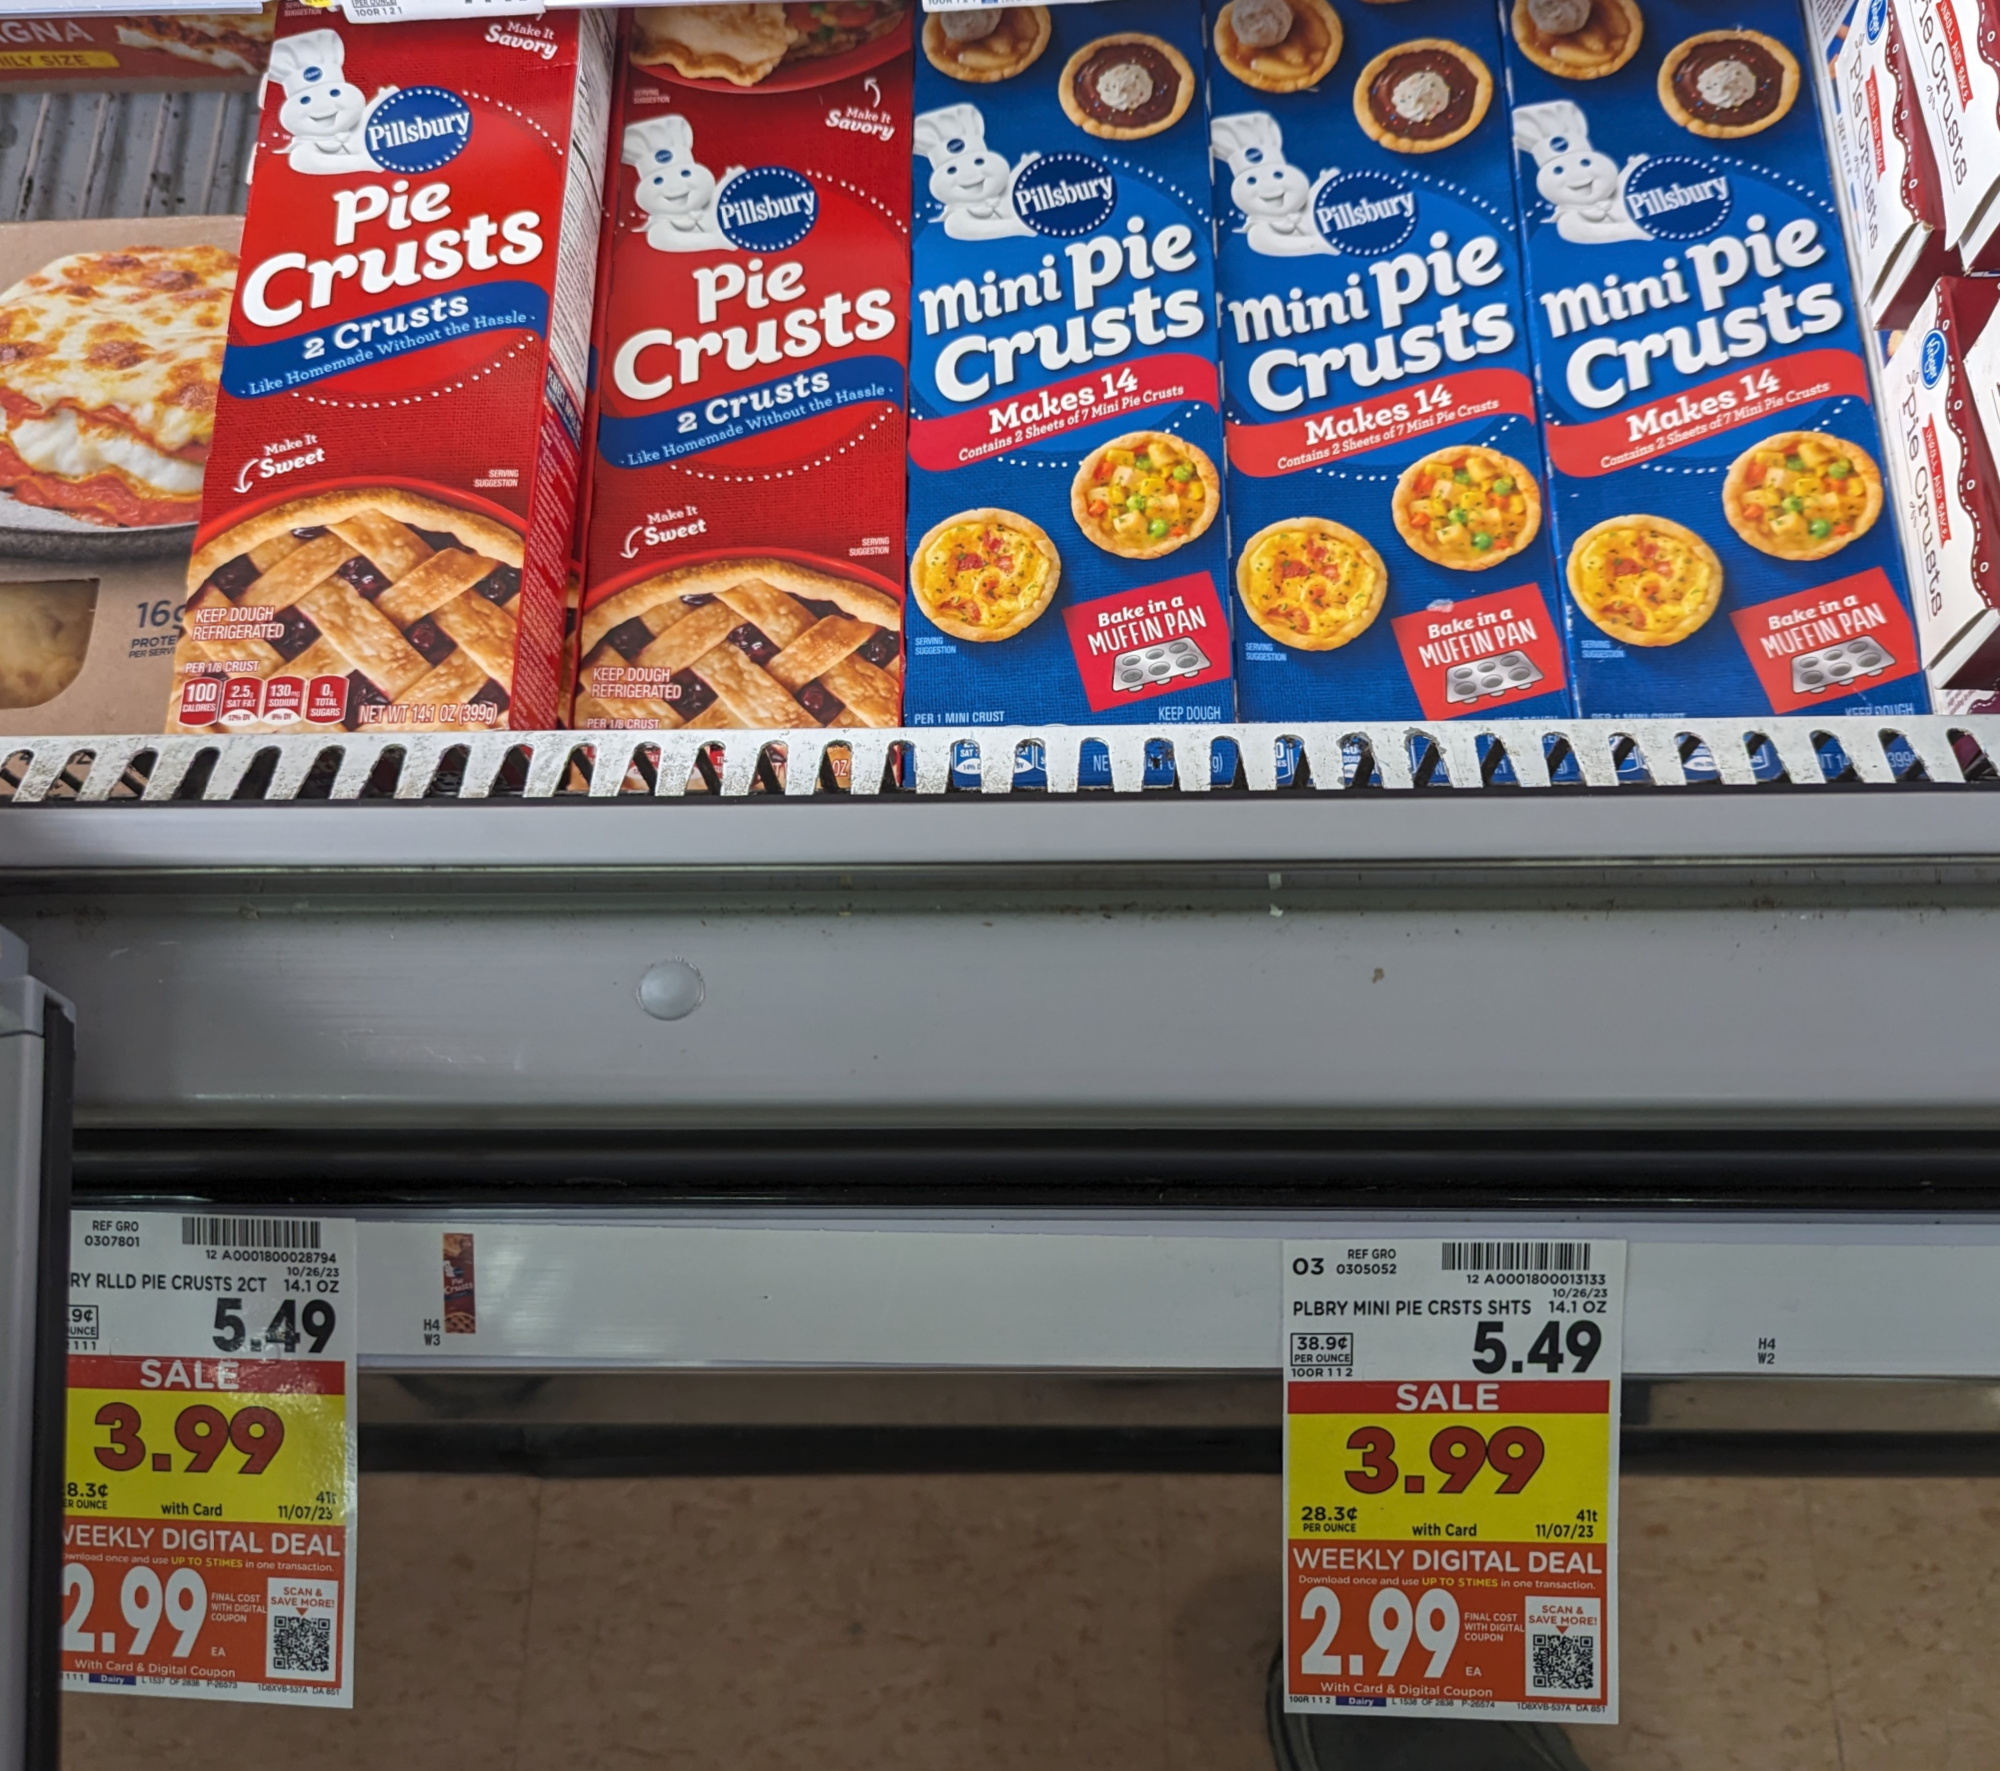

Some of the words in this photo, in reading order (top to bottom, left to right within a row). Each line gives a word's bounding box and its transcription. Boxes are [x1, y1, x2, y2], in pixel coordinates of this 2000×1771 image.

[0, 20, 94, 43] GNA
[485, 24, 558, 59] Savory
[0, 54, 33, 67] ILY
[42, 54, 90, 66] SIZE
[1850, 51, 1866, 118] Pie
[1931, 42, 1968, 186] Crusts
[367, 108, 471, 150] Pillsbury
[1014, 174, 1114, 217] Pillsbury
[1857, 116, 1879, 249] Crusts
[719, 190, 816, 231] Pillsbury
[1626, 175, 1729, 220] Pillsbury
[333, 180, 451, 246] Pie
[1316, 191, 1415, 235] Pillsbury
[241, 210, 544, 328] Crusts
[918, 254, 1063, 336] mini
[1064, 216, 1198, 311] pie
[1539, 257, 1691, 338] mini
[1685, 213, 1827, 311] pie
[692, 258, 807, 324] Pie
[1227, 273, 1370, 344] mini
[1368, 230, 1505, 329] pie
[302, 335, 326, 360] 2
[335, 295, 470, 350] Crusts
[249, 377, 284, 395] Like
[285, 349, 375, 386] Homemade
[377, 326, 443, 354] Without
[445, 320, 471, 340] the
[473, 311, 528, 331] Hassle
[612, 288, 897, 401] Crusts
[934, 286, 1206, 404] Crusts
[1247, 303, 1516, 413] Crusts
[1565, 282, 1844, 410] Crusts
[676, 411, 699, 434] 2
[705, 371, 831, 426] Crusts
[988, 386, 1097, 436] Makes
[1101, 367, 1139, 400] 14
[1303, 398, 1411, 446] Makes
[1413, 383, 1453, 414] 14
[957, 436, 1014, 463] Contains
[1014, 430, 1025, 444] 2
[1024, 417, 1066, 440] Sheets
[1066, 409, 1081, 426] of
[1081, 407, 1090, 421] 7
[1091, 399, 1121, 420] Mini
[1121, 393, 1142, 411] Pie
[1142, 383, 1186, 405] Crusts
[259, 447, 327, 479] Sweet
[1902, 387, 1921, 461] Pie
[1914, 466, 1943, 617] Crusts
[194, 607, 228, 624] KEEP
[228, 605, 276, 623] DOUGH
[192, 623, 286, 641] REFRIGERATED
[914, 637, 944, 646] SERVING
[1086, 615, 1167, 656] MUFFIN
[1165, 605, 1208, 635] PAN
[1418, 624, 1499, 668] MUFFIN
[1495, 618, 1539, 651] PAN
[914, 646, 957, 655] SUGGESTION
[187, 682, 218, 702] 100
[590, 683, 683, 699] REFRIGERATED
[358, 704, 386, 724] NET
[386, 703, 413, 724] WT
[413, 704, 436, 724] 14.1
[438, 704, 459, 723] OZ
[458, 703, 498, 725] (399g)
[914, 713, 935, 725] PER
[945, 712, 971, 724] MINI
[972, 711, 1005, 724] CRUST
[1158, 707, 1185, 721] KEEP
[1185, 706, 1222, 721] DOUGH
[92, 1220, 113, 1231] REF
[115, 1220, 139, 1232] GRO
[84, 1235, 140, 1248] 0307801
[1348, 1249, 1369, 1259] REF
[1372, 1249, 1397, 1259] GRO
[205, 1249, 218, 1260] 12
[221, 1250, 337, 1264] A0001800028794
[1336, 1263, 1397, 1275] 0305052
[95, 1273, 137, 1289] RLLD
[141, 1274, 167, 1289] PIE
[171, 1275, 233, 1291] CRUSTS
[236, 1276, 267, 1292] 2CT
[283, 1279, 312, 1293] 14.1
[316, 1280, 340, 1293] OZ
[286, 1266, 340, 1278] 10/26/23
[1466, 1275, 1479, 1284] 12
[1484, 1274, 1606, 1286] A0001800013133
[1552, 1288, 1608, 1299] 10/26/23
[1293, 1301, 1348, 1316] PLBRY
[1354, 1301, 1390, 1316] MINI
[1396, 1300, 1423, 1316] PIE
[1427, 1300, 1483, 1315] CRSTS
[1487, 1300, 1531, 1315] SHTS
[1548, 1301, 1578, 1314] 14.1
[1583, 1301, 1608, 1314] OZ
[211, 1297, 336, 1354] 5.49
[424, 1319, 440, 1331] H4
[424, 1334, 441, 1346] W3
[1471, 1319, 1602, 1374] 5.49
[1758, 1337, 1776, 1350] H4
[1757, 1352, 1776, 1365] W2
[140, 1359, 240, 1390] SALE
[1396, 1383, 1500, 1411] SALE
[94, 1401, 285, 1475] 3.99
[1344, 1425, 1545, 1495] 3.99
[160, 1502, 189, 1516] with
[193, 1503, 223, 1517] Card
[162, 1528, 263, 1552] DIGITAL
[271, 1531, 341, 1557] DEAL
[1412, 1523, 1442, 1537] with
[1445, 1523, 1478, 1538] Card
[1535, 1524, 1594, 1539] 11/07/23
[1293, 1548, 1405, 1571] WEEKLY
[1412, 1550, 1521, 1573] DIGITAL
[1528, 1552, 1603, 1575] DEAL
[283, 1586, 314, 1596] SCAN
[315, 1587, 323, 1597] &
[1298, 1575, 1350, 1585] Download
[1352, 1577, 1378, 1586] once
[1379, 1576, 1401, 1586] and
[1401, 1578, 1420, 1587] use
[1422, 1577, 1438, 1586] UP
[1439, 1577, 1455, 1586] TO
[1500, 1579, 1511, 1588] in
[1512, 1581, 1533, 1589] one
[1535, 1580, 1596, 1590] transaction.
[62, 1562, 208, 1658] 2.99
[1464, 1612, 1491, 1622] FINAL
[1493, 1612, 1518, 1622] COST
[1528, 1615, 1560, 1625] SAVE
[1561, 1615, 1598, 1626] MORE!
[1541, 1605, 1574, 1615] SCAN
[1575, 1605, 1584, 1615] &
[1300, 1585, 1461, 1678] 2.99
[1464, 1622, 1488, 1632] WITH
[1489, 1623, 1526, 1633] DIGITAL
[1464, 1632, 1504, 1642] COUPON
[1320, 1681, 1350, 1693] With
[1354, 1682, 1383, 1695] Card
[1386, 1684, 1397, 1695] &
[1399, 1684, 1440, 1699] Digital
[1443, 1685, 1494, 1700] Coupon
